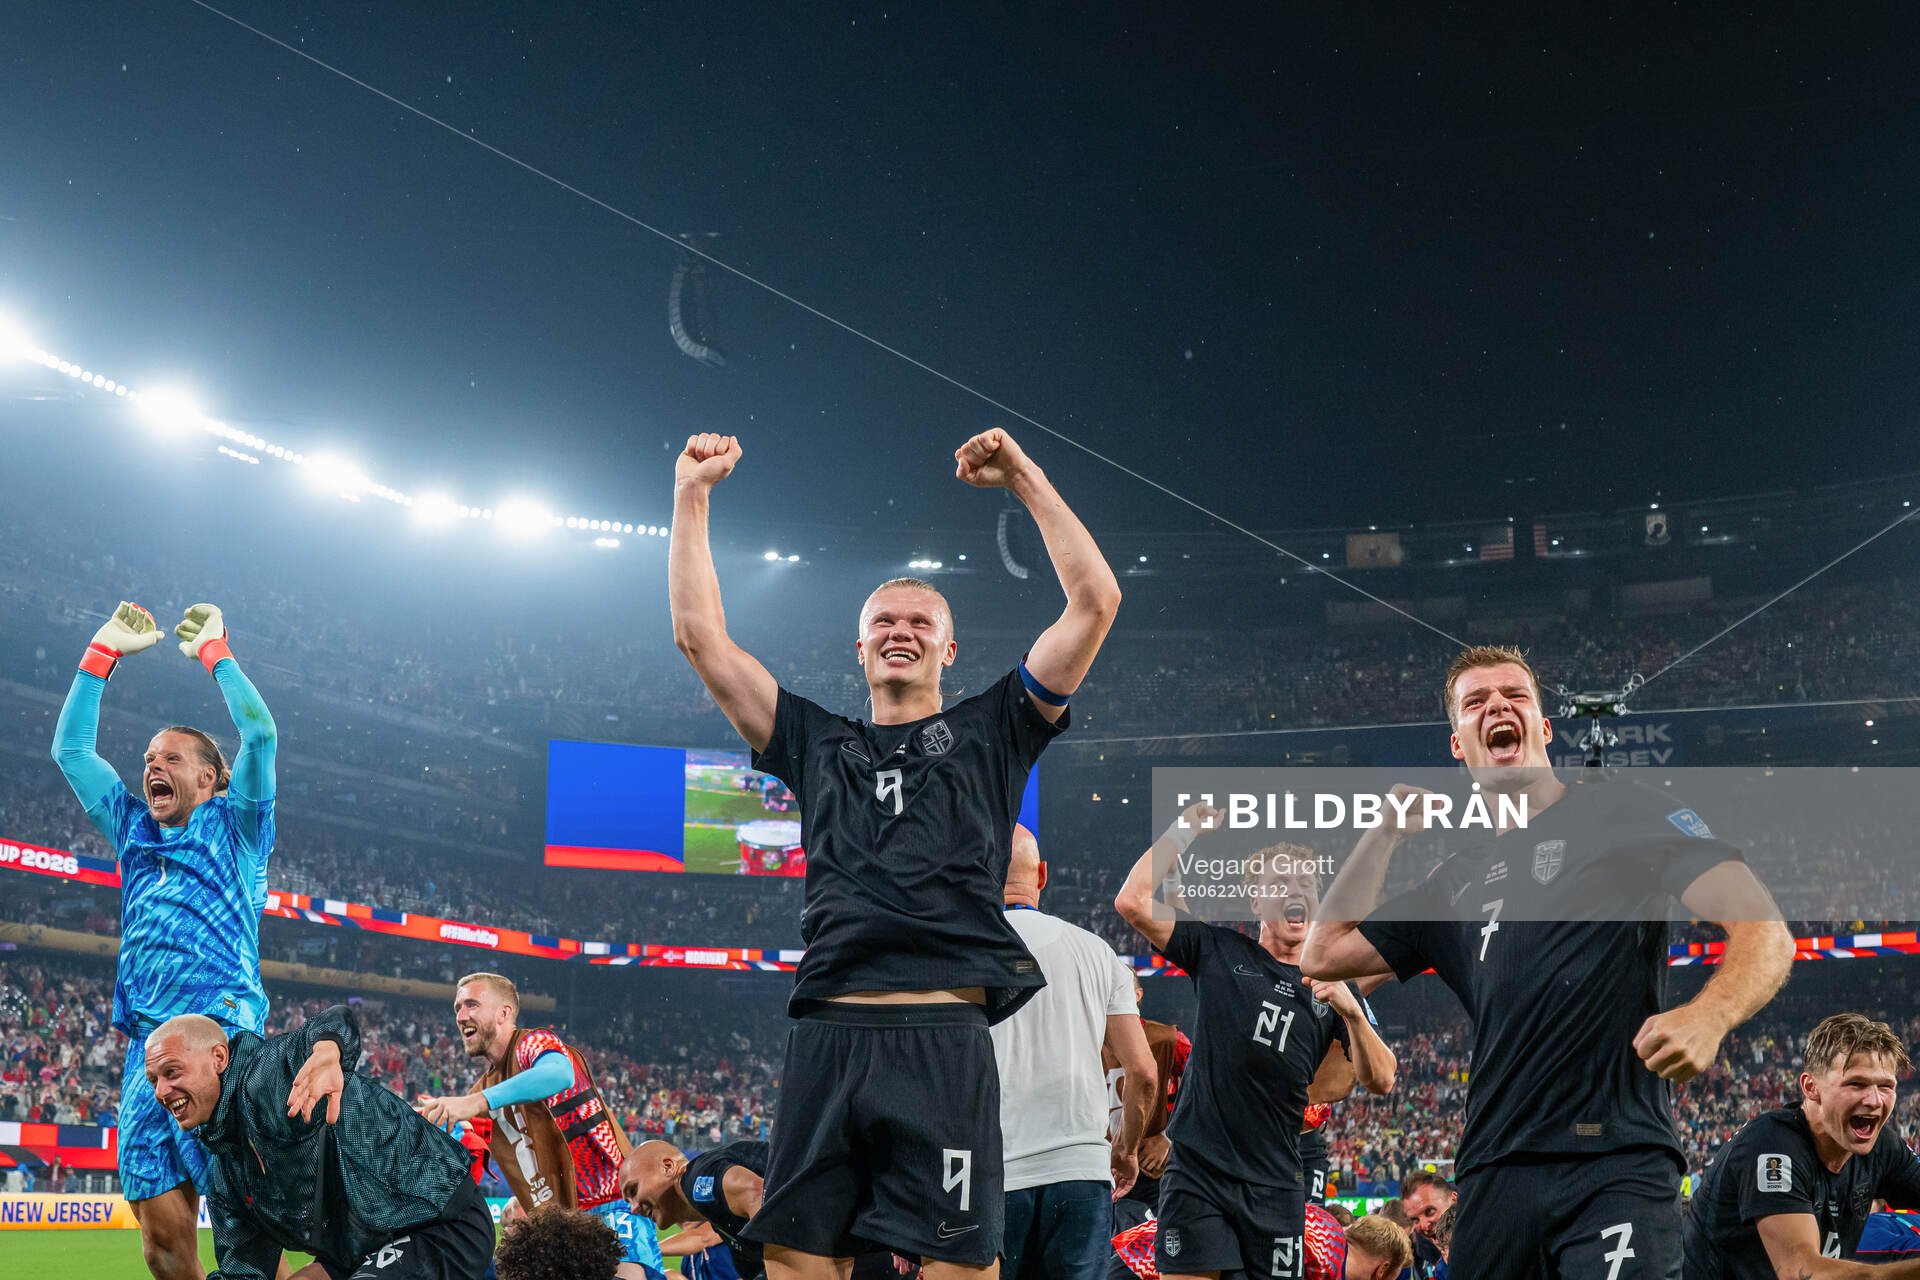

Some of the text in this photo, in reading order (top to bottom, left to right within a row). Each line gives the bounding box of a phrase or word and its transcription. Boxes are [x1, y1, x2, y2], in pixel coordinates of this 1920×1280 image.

[1560, 722, 1674, 749] YRK
[875, 767, 904, 816] 9
[20, 847, 79, 875] 2026
[1479, 898, 1504, 962] 7
[1252, 1000, 1296, 1053] 21
[942, 1148, 972, 1212] 9
[1, 1201, 115, 1223] NEW JERSEY
[1271, 1234, 1303, 1278] 21
[1600, 1222, 1636, 1280] 7
